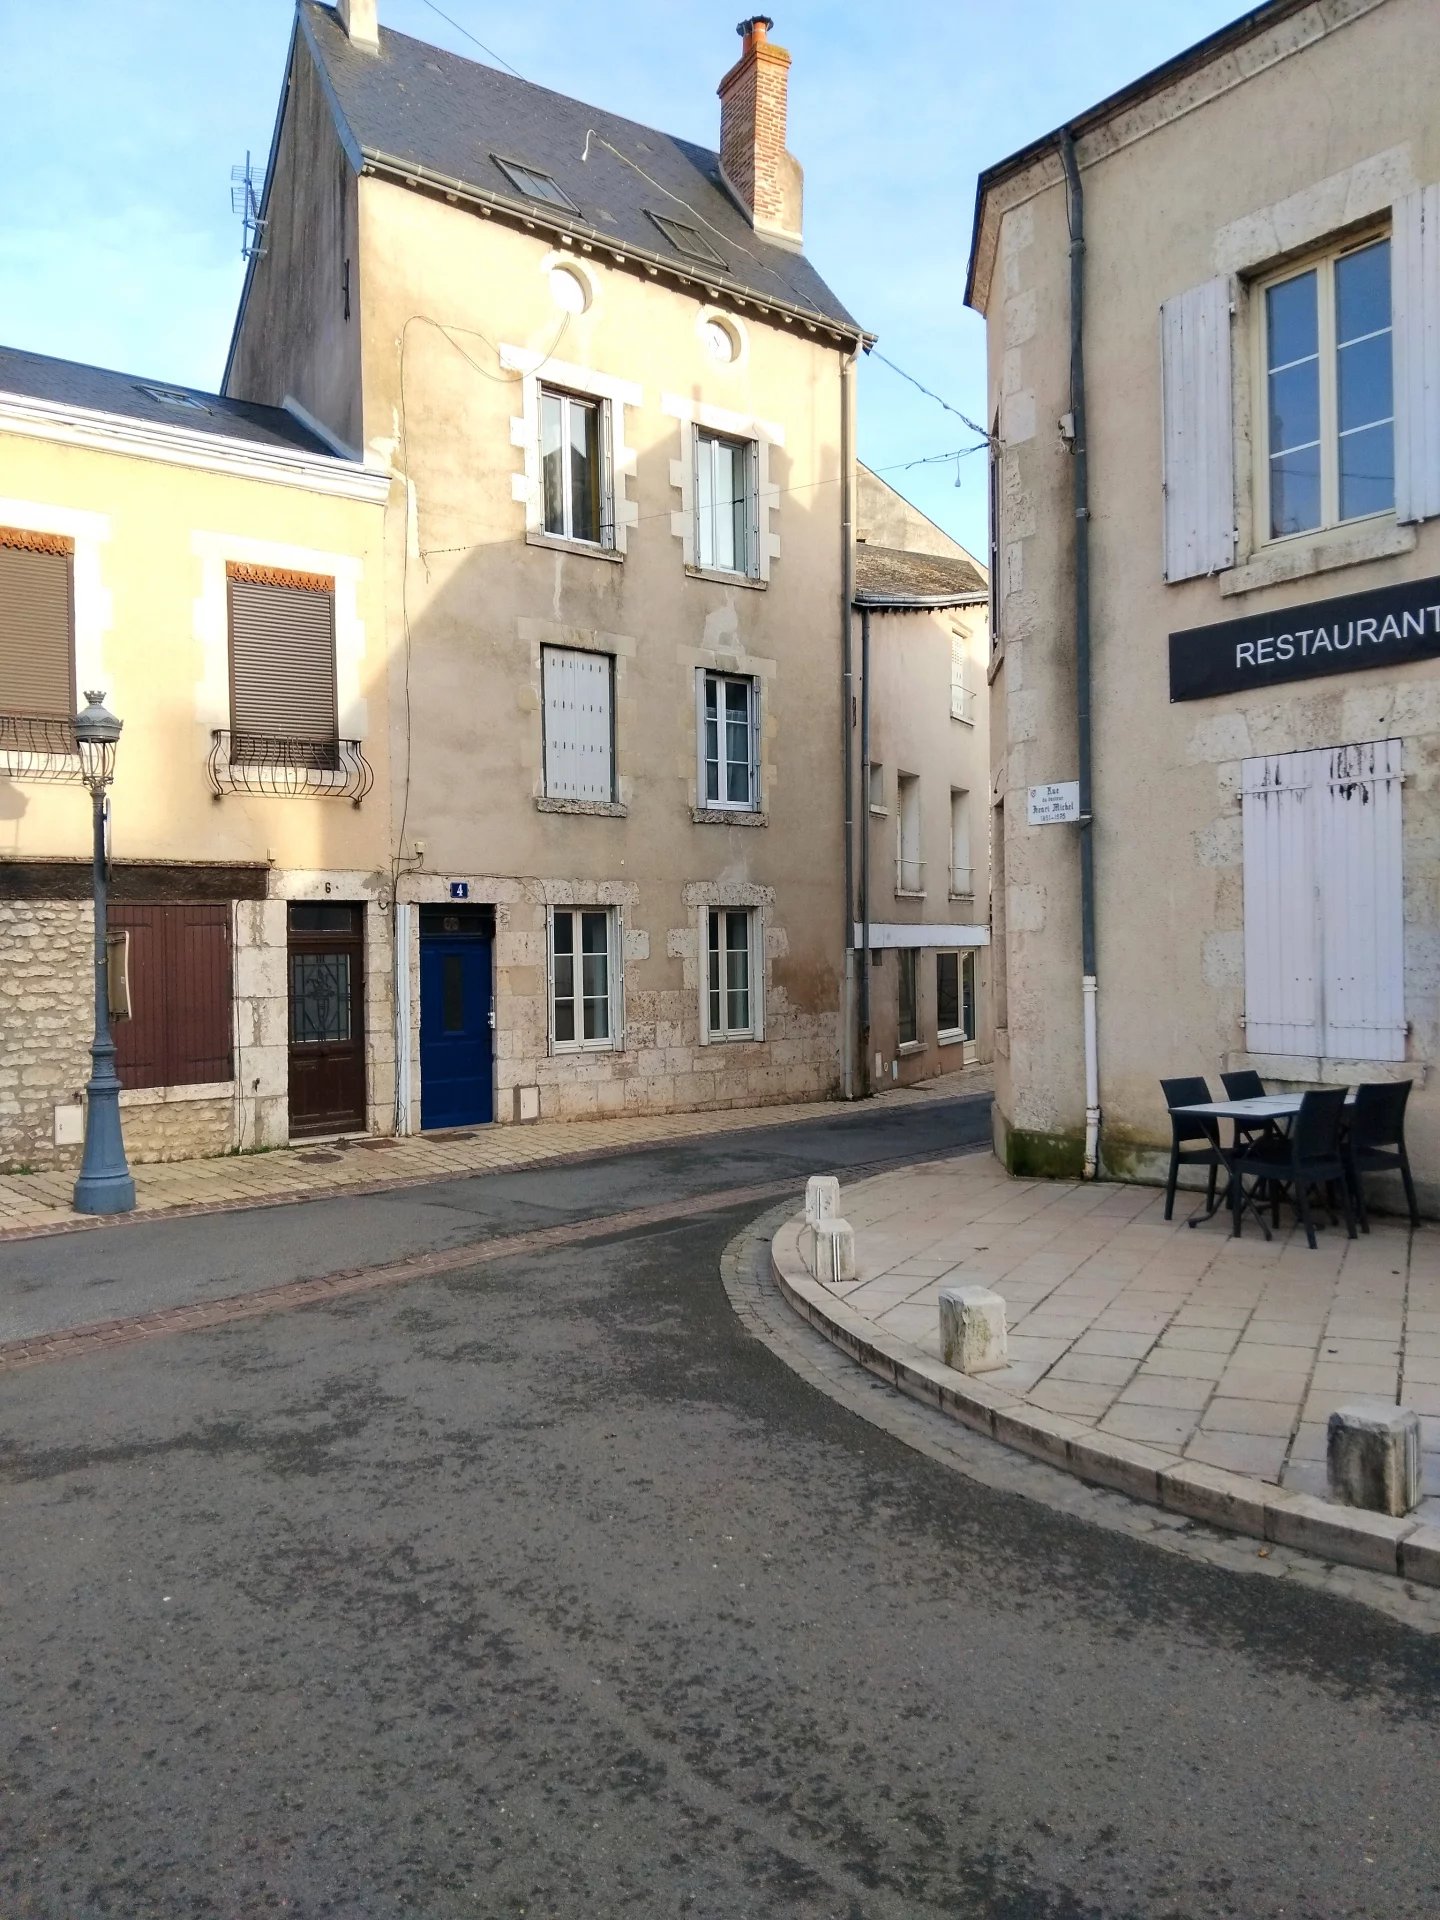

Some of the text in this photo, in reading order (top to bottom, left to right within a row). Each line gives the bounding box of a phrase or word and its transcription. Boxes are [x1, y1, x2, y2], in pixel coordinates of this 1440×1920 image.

[1235, 605, 1440, 669] RESTAURANT
[1047, 786, 1059, 795] Rue
[1032, 802, 1074, 814] Henri Michel
[325, 882, 331, 893] 6
[456, 883, 464, 896] 4
